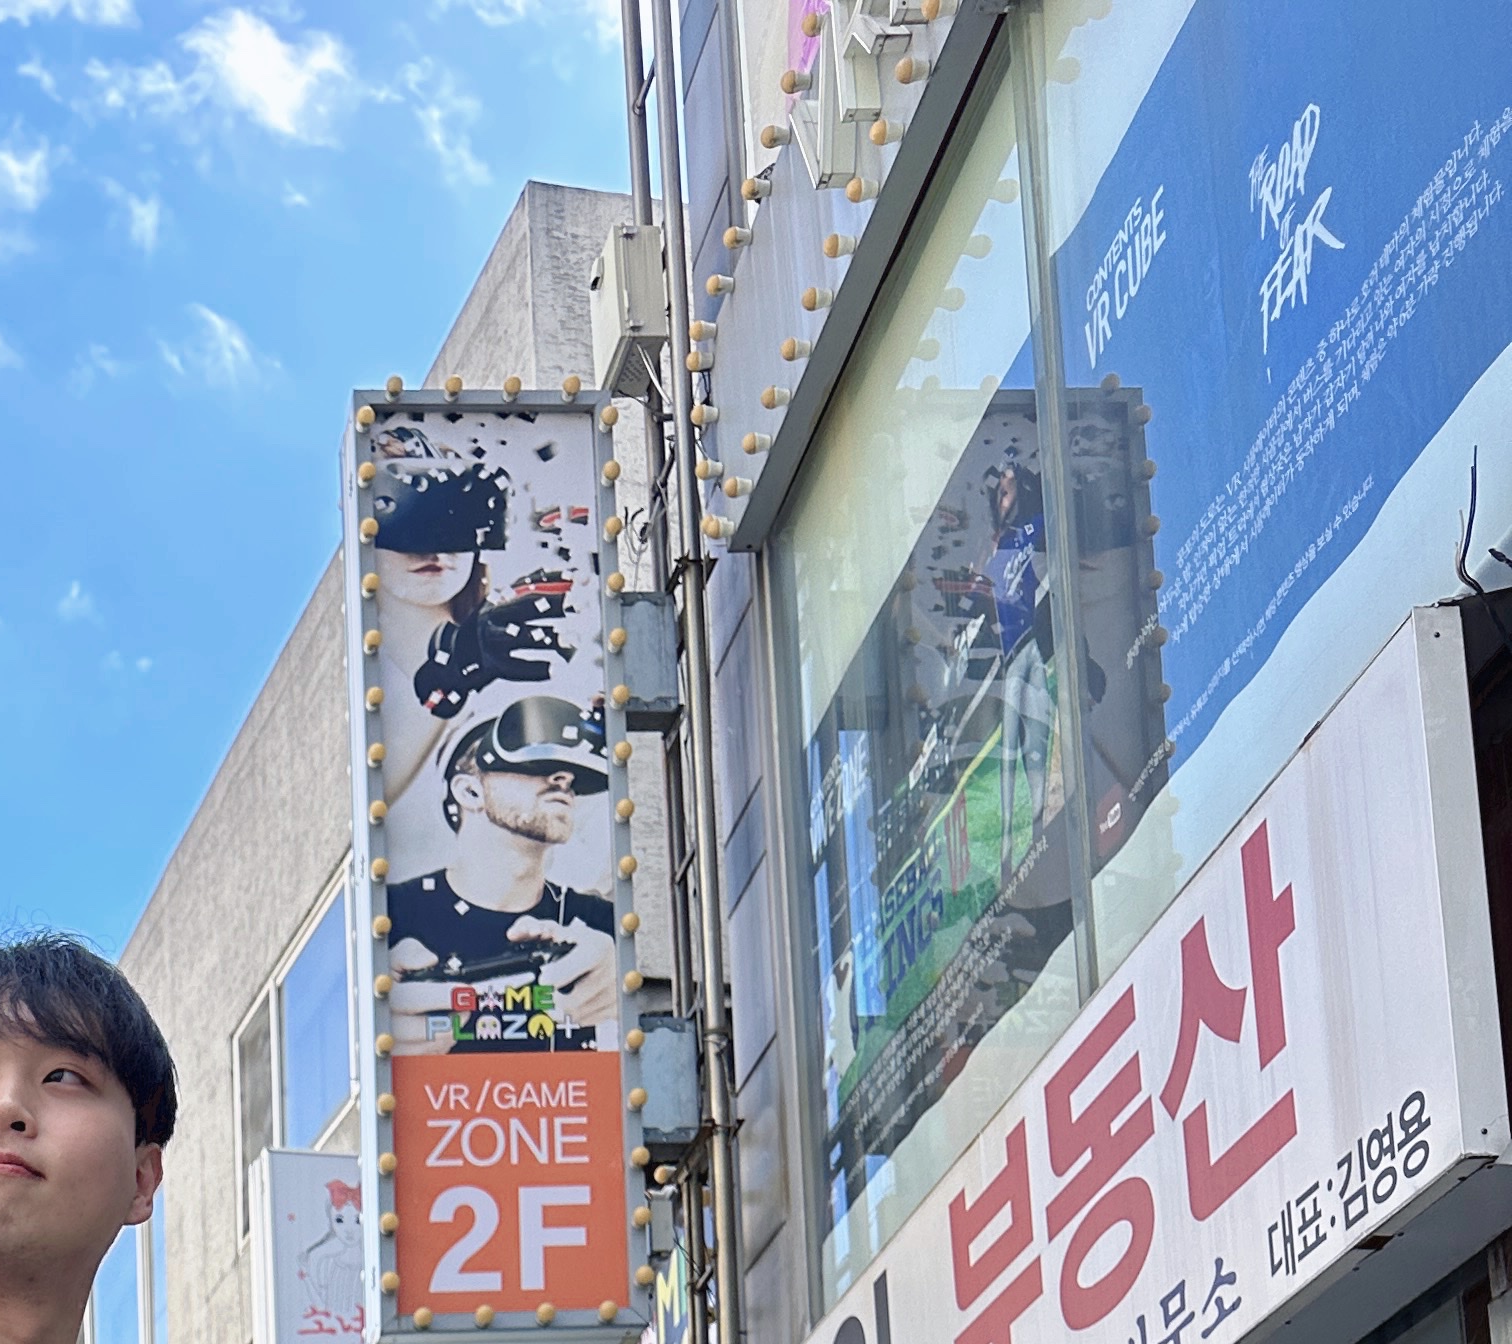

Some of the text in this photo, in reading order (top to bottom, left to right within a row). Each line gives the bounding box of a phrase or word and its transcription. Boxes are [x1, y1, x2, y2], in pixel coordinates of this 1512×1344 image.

[1085, 184, 1166, 370] VR CUBE
[1086, 196, 1142, 312] CONTENTS
[1336, 304, 1373, 362] 기다리고
[1394, 221, 1427, 273] 여자의
[1428, 158, 1476, 224] 시점으로
[1225, 471, 1243, 497] VR
[1328, 296, 1360, 345] 하나로
[425, 1116, 589, 1167] ZONE
[428, 1185, 591, 1293] 2F
